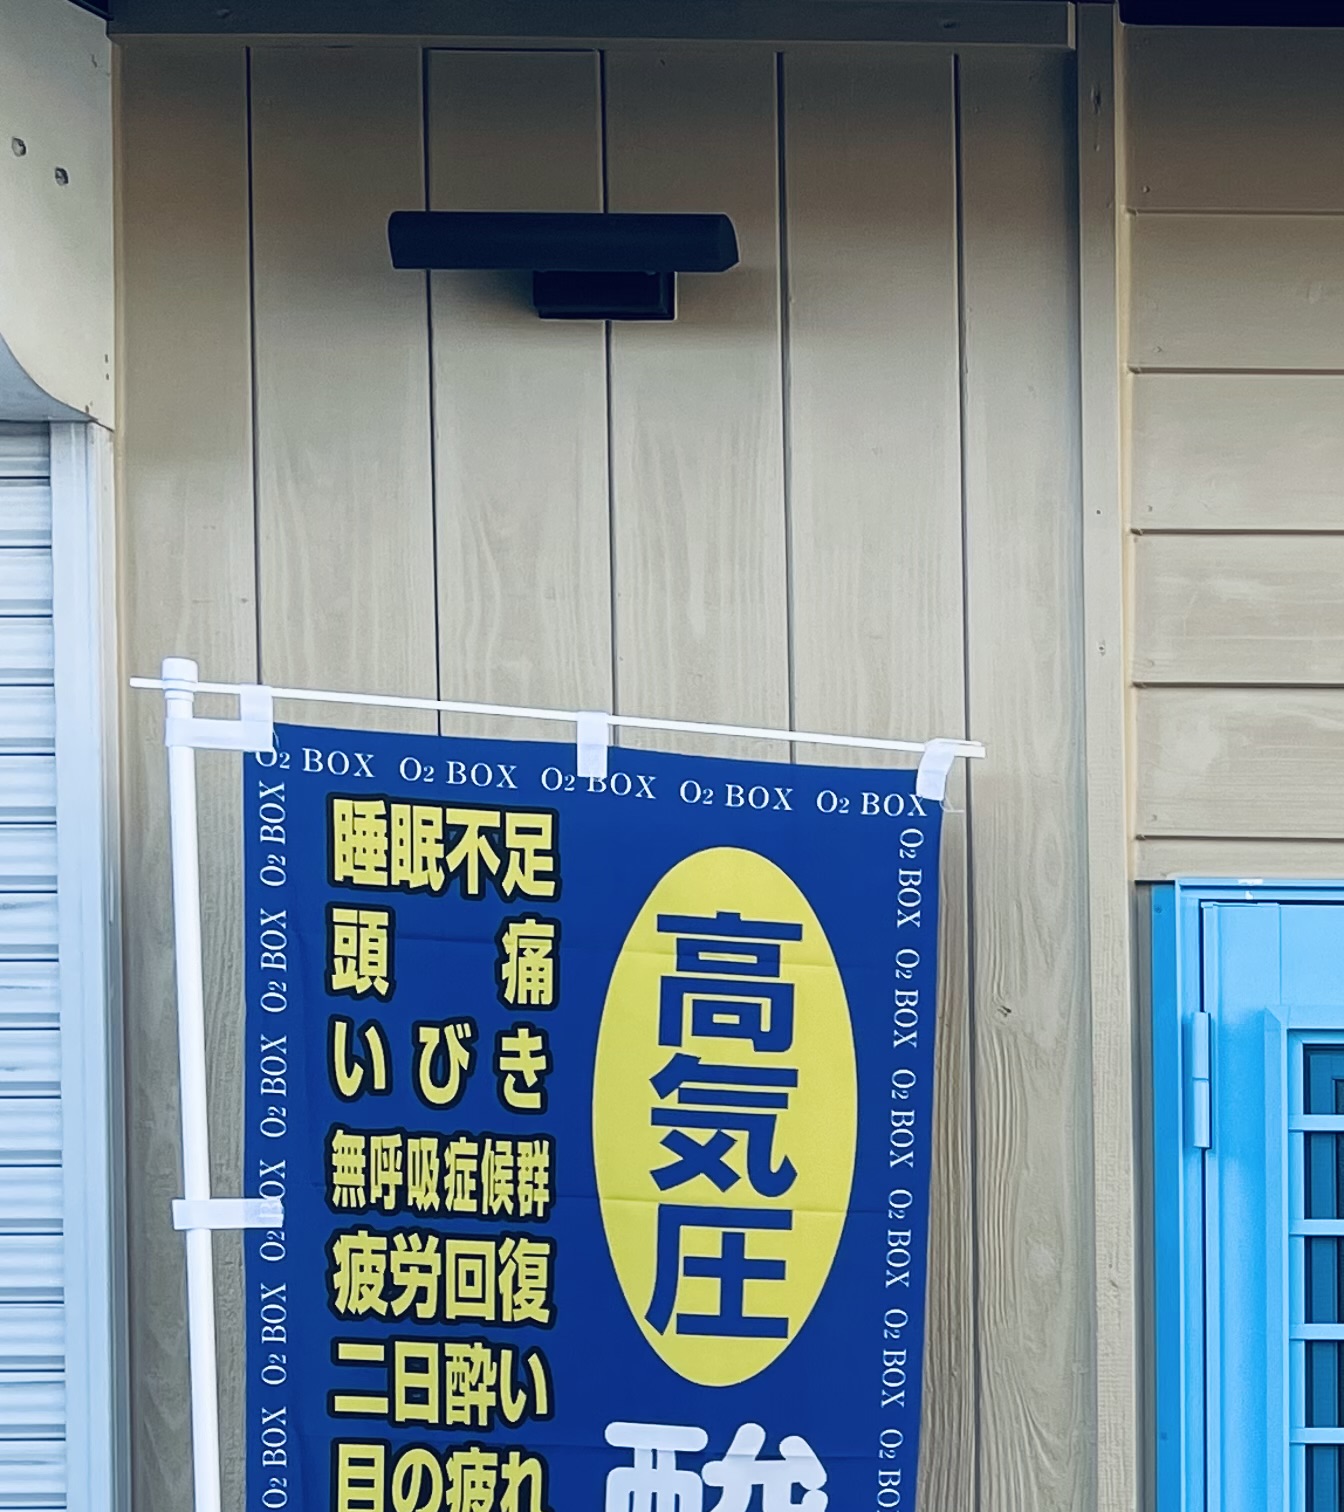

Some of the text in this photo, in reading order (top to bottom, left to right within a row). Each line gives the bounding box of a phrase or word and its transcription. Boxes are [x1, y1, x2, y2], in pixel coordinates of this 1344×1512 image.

[258, 780, 286, 845] BOX
[302, 748, 375, 778] BOX
[446, 760, 518, 789] BOX
[725, 784, 794, 811] BOX
[860, 792, 928, 817] BOX
[333, 799, 556, 896] 睡眠不足
[896, 868, 922, 928] BOX
[260, 907, 287, 972] BOX
[893, 989, 919, 1048] BOX
[260, 1034, 287, 1097] BOX
[644, 911, 804, 1341] 高気圧
[889, 1109, 915, 1168] BOX
[332, 1129, 550, 1217] 無呼吸症候群
[332, 1230, 551, 1323] 疲労回復
[885, 1229, 912, 1288] BOX
[260, 1283, 287, 1344] BOX
[334, 1341, 548, 1426] 二日酔い
[881, 1349, 907, 1407] BOX
[261, 1406, 287, 1467] BOX
